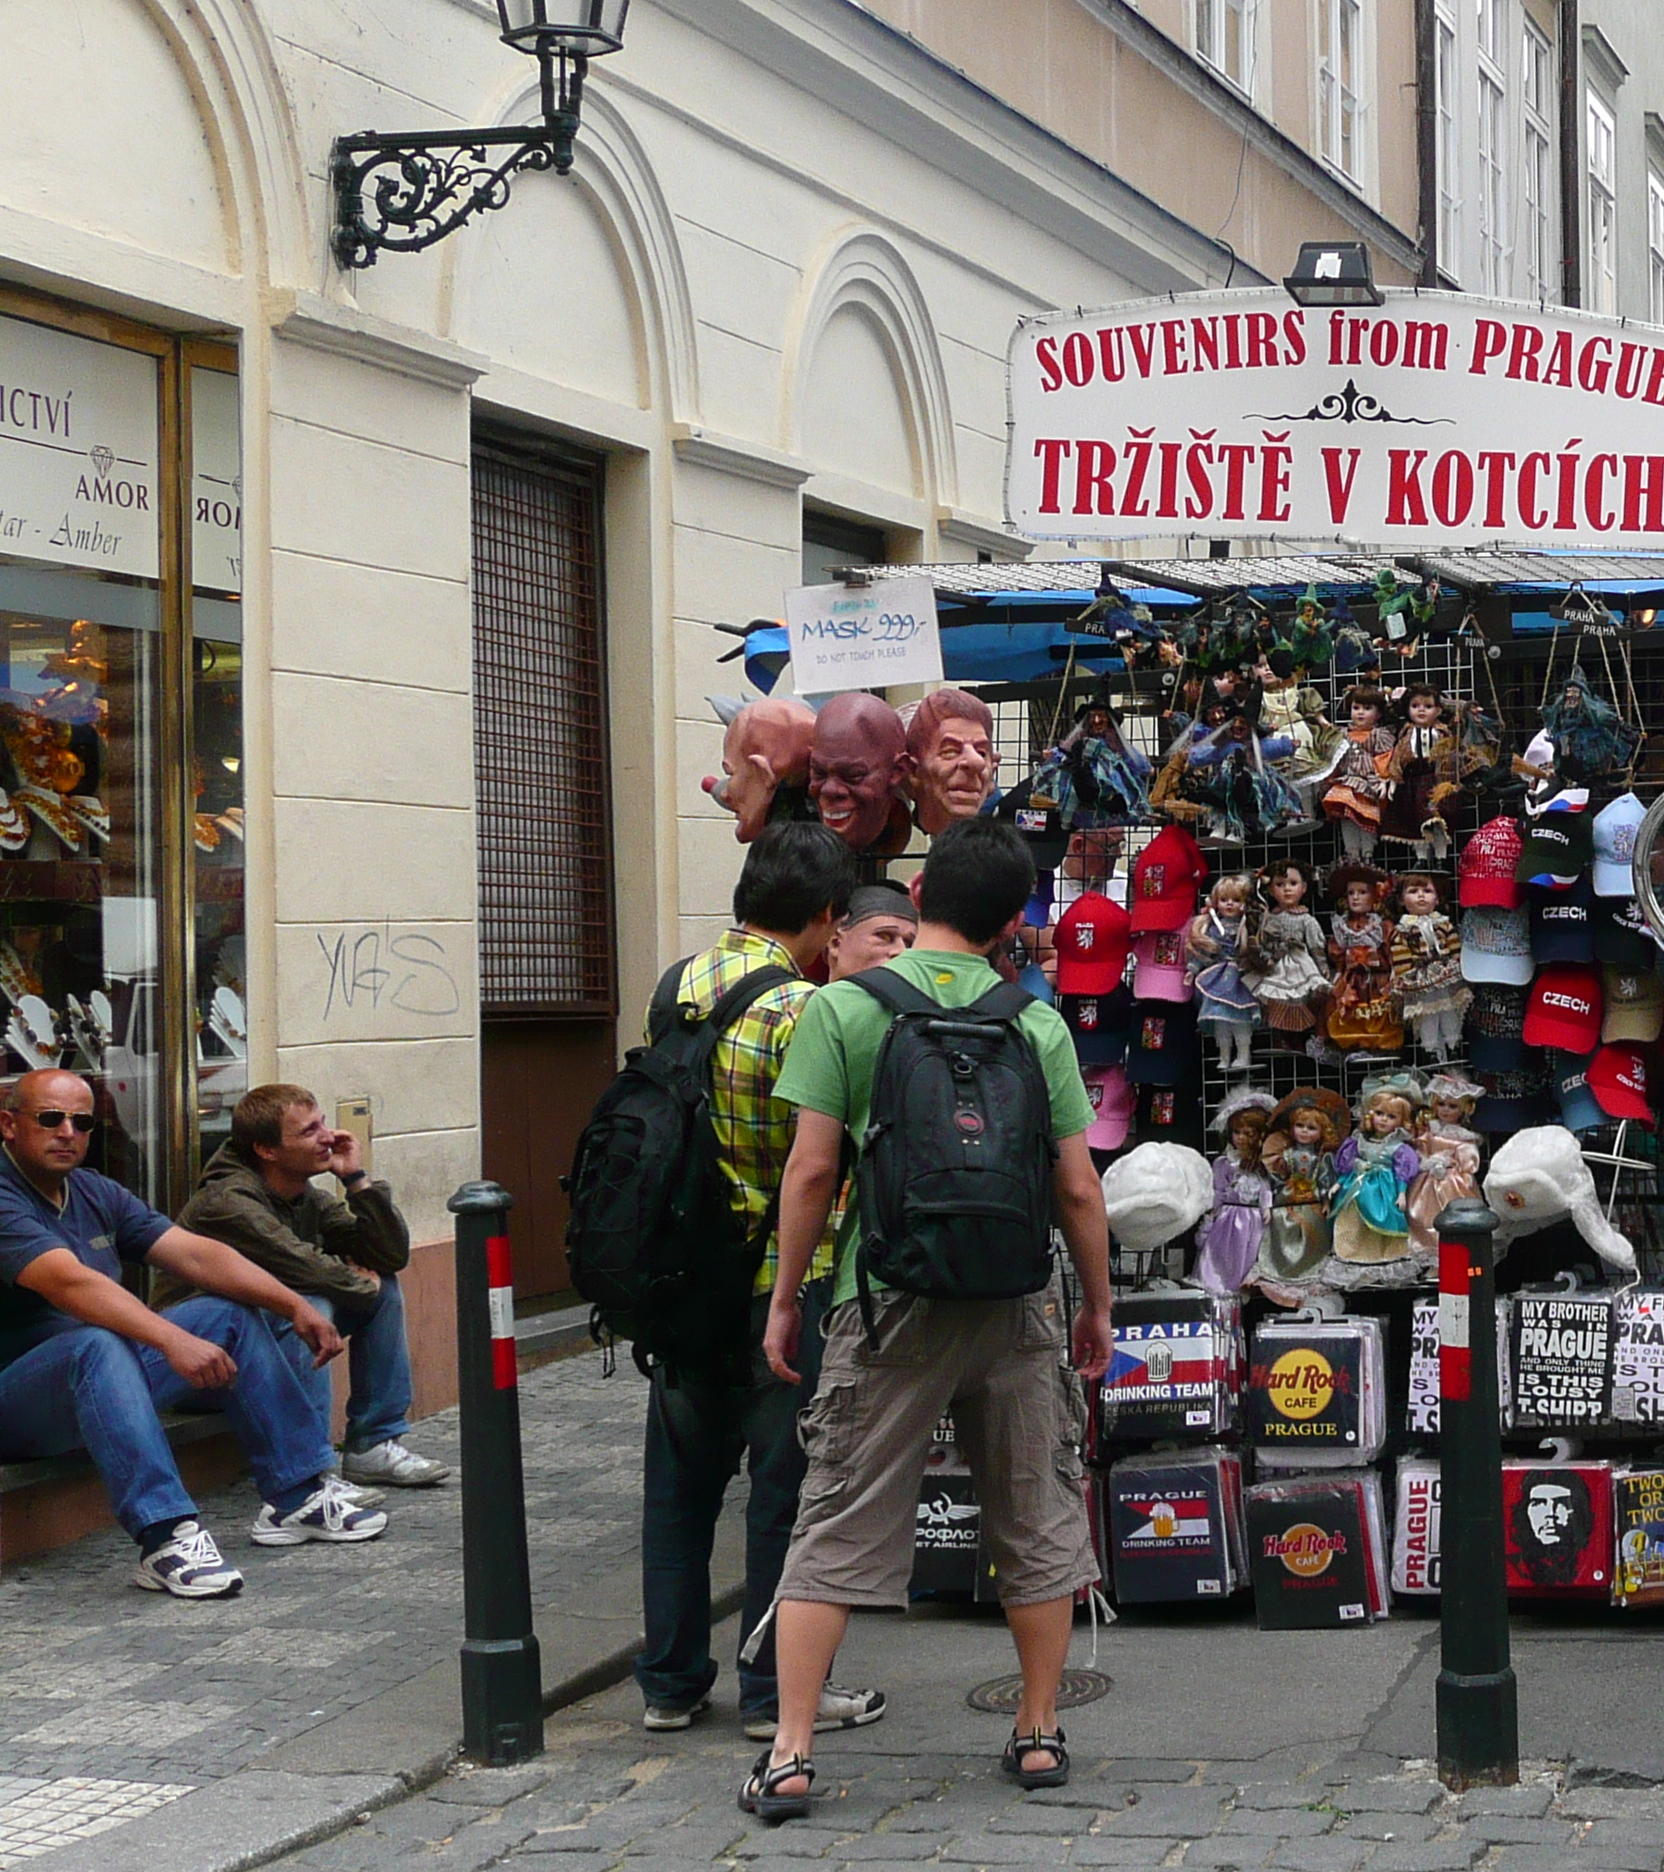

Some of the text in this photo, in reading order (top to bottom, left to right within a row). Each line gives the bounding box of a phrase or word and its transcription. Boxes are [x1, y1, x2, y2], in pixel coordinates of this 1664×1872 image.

[1035, 309, 1307, 392] SOUVENIRS
[1327, 309, 1450, 371] from
[1034, 426, 1293, 523] TRŽIŠTĚ
[1321, 447, 1361, 525] V
[75, 475, 150, 511] AMOR
[49, 513, 123, 556] Amber
[802, 616, 873, 641] MASK
[816, 653, 827, 665] DO
[831, 652, 846, 663] NOT
[1531, 828, 1570, 846] CZECH
[1542, 905, 1588, 922] CZECH
[1543, 991, 1591, 1016] CZECH
[1521, 1301, 1609, 1323] MY BROTHER
[1619, 1296, 1647, 1312] MY
[1522, 1318, 1608, 1332] WAS IN
[1519, 1328, 1609, 1361] PRAGUE
[1520, 1356, 1606, 1368] AND ONLY THING
[1520, 1363, 1606, 1375] HE BROUGHT ME
[1250, 1364, 1350, 1394] Hard Rock
[1518, 1373, 1604, 1389] IS THIS
[1104, 1384, 1171, 1402] DRINKING
[1174, 1382, 1214, 1397] TEAM
[1518, 1384, 1602, 1399] LOUSY
[1284, 1397, 1317, 1409] CAFE
[1264, 1422, 1338, 1436] PRAGUE
[1624, 1476, 1664, 1493] TWO
[1119, 1489, 1208, 1502] PRAGUE
[1639, 1490, 1664, 1507] OR
[1405, 1478, 1429, 1588] PRAGUE
[1121, 1536, 1211, 1549] DRINKING TEAM
[1263, 1530, 1348, 1557] Hard Rock
[1295, 1555, 1320, 1567] CAFE
